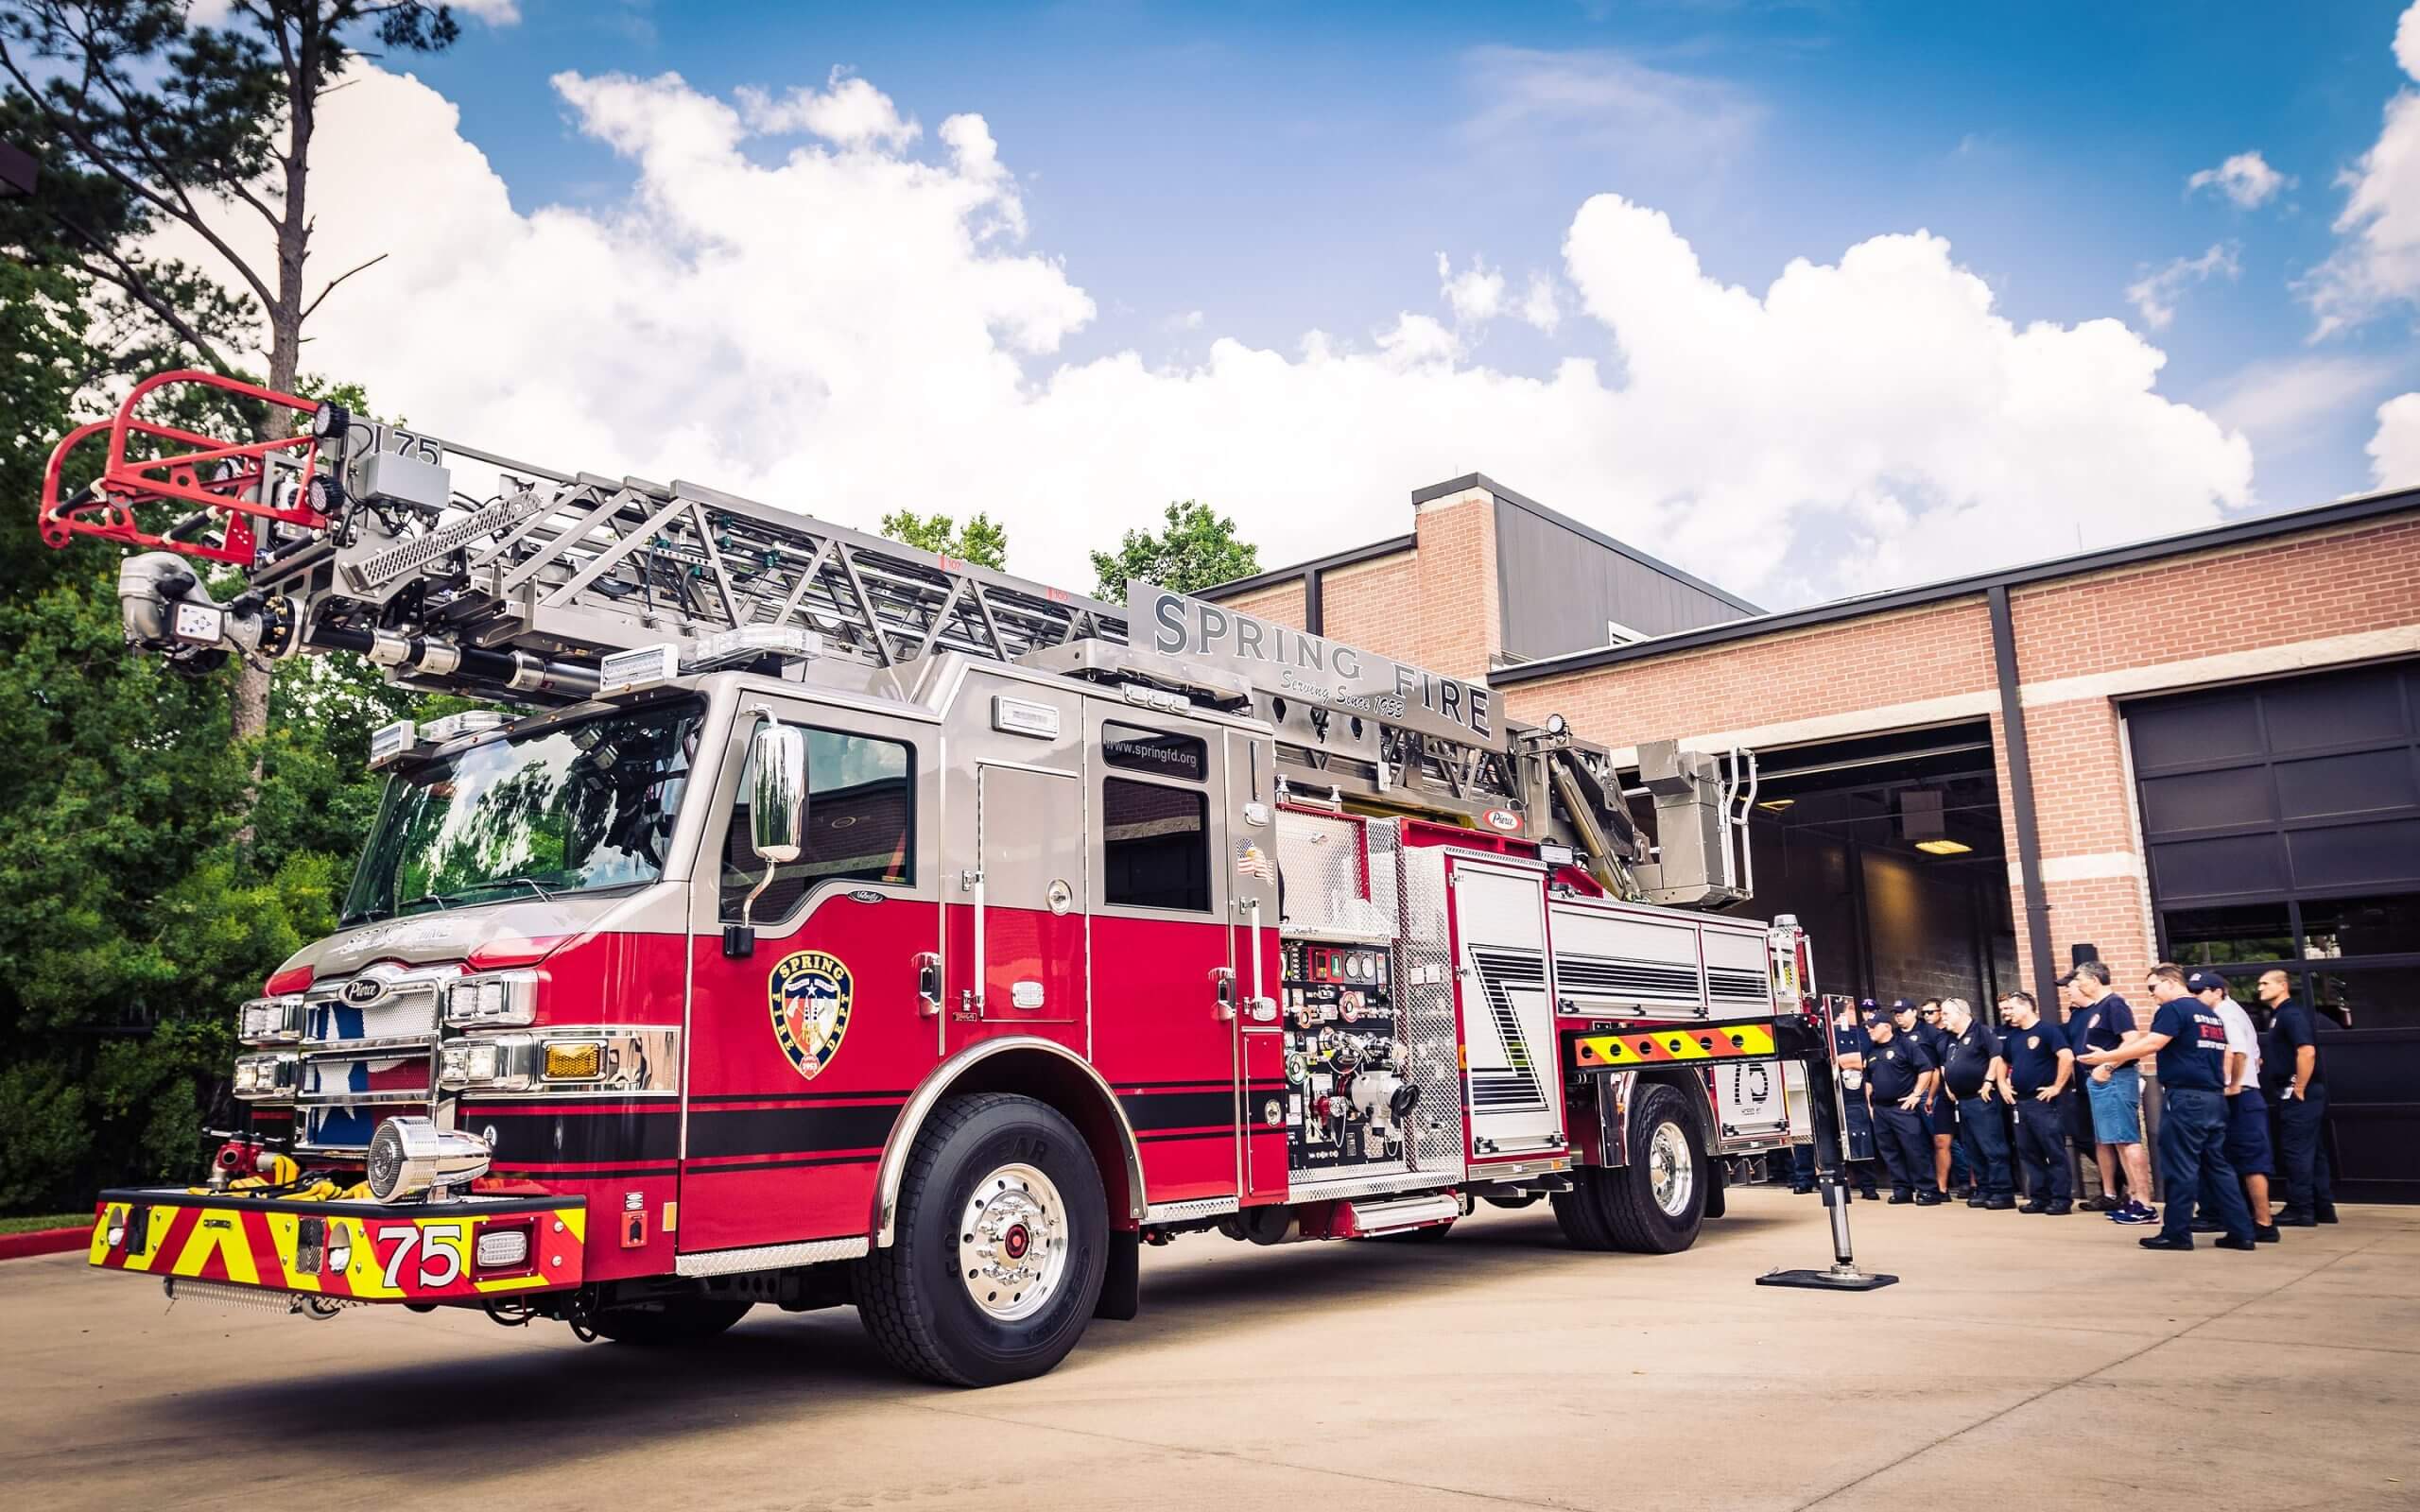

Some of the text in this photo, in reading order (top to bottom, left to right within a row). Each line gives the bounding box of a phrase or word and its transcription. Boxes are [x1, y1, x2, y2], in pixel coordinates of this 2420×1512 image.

[1152, 592, 1493, 742] SPRING FIRE
[1280, 669, 1405, 720] Serving Since 1953
[1104, 739, 1198, 768] www.springfd.org
[778, 954, 845, 981] SPRING
[770, 992, 796, 1052] FIRE
[825, 992, 851, 1052] DEPT
[376, 1224, 462, 1290] 75
